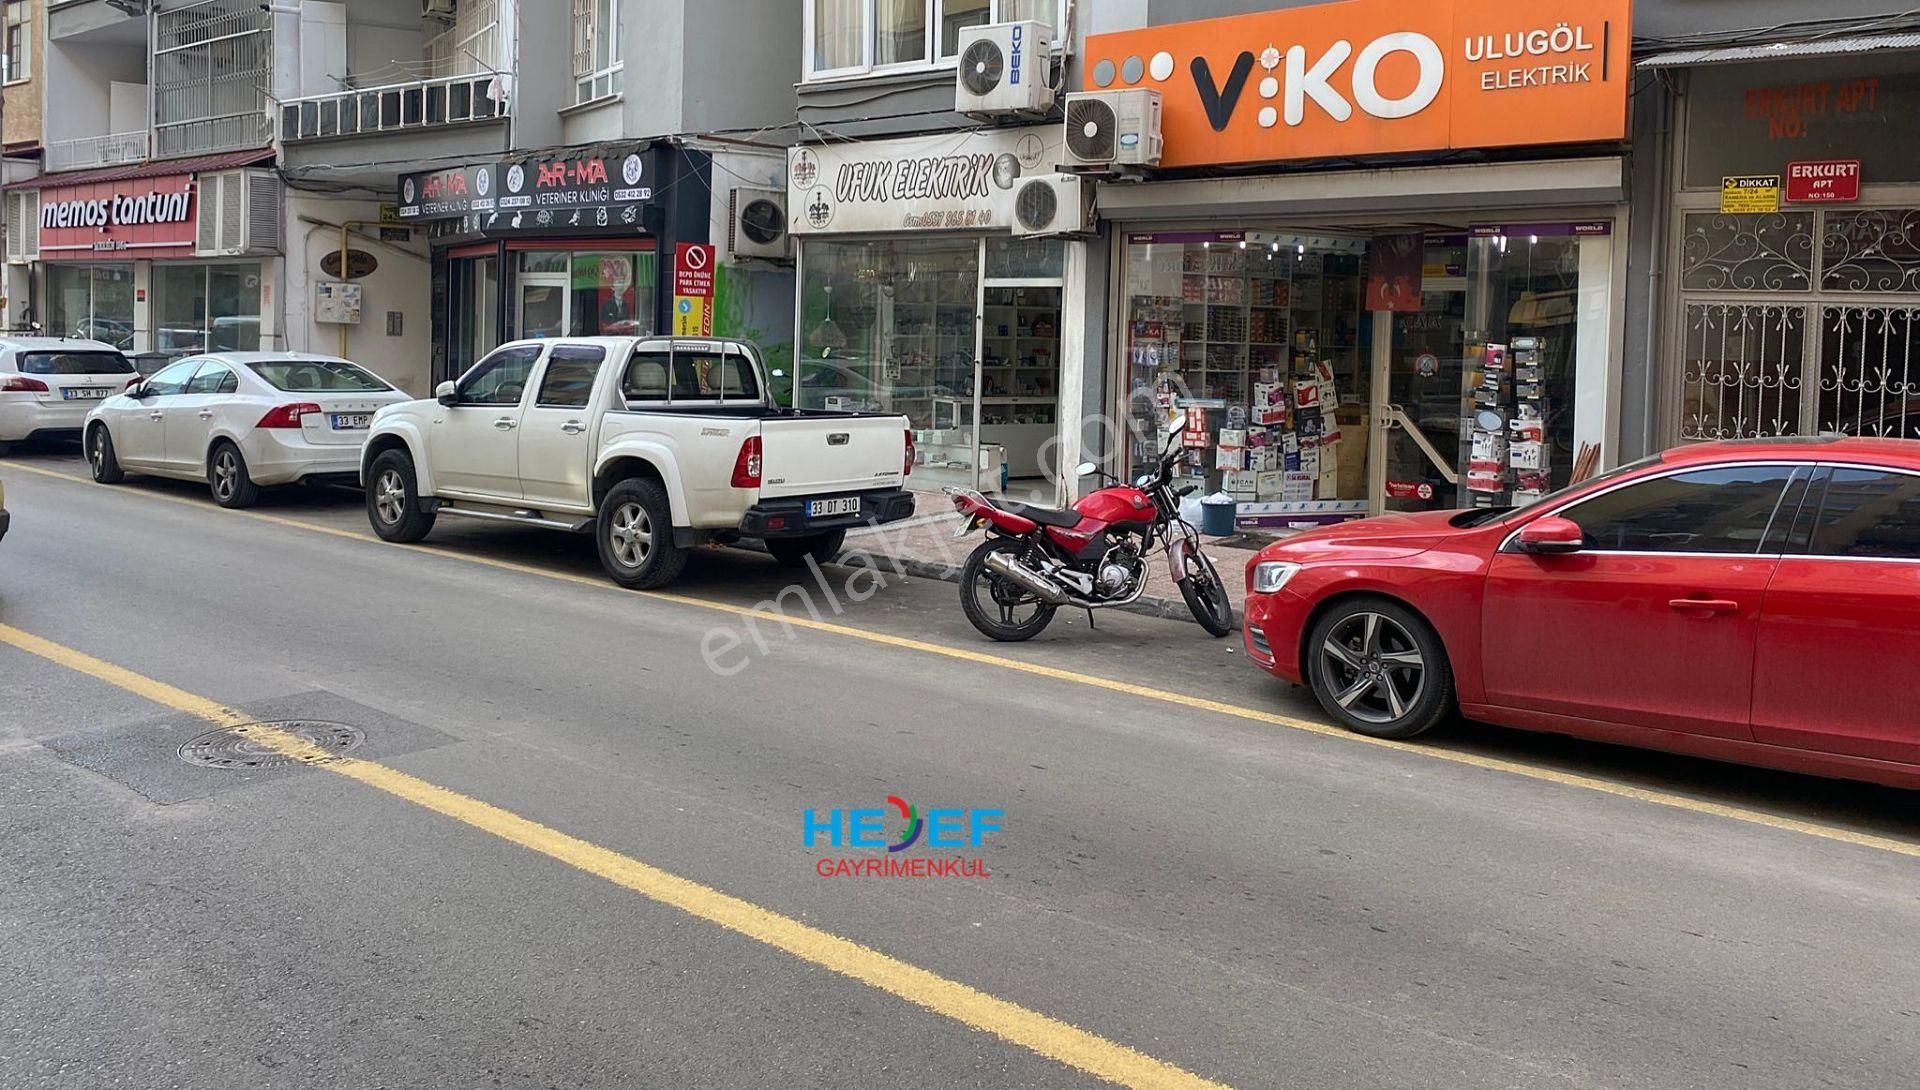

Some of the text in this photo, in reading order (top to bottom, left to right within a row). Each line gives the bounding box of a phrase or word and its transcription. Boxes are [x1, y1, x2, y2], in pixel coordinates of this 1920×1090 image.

[1010, 25, 1022, 85] BEKO
[1464, 22, 1594, 62] ULUGÖL
[1481, 60, 1592, 91] ELEKTRİK
[1746, 79, 1880, 118] ERKURT APT
[536, 158, 609, 188] AR-MA
[836, 154, 994, 203] UFUK ELEKTRİK
[1739, 178, 1775, 188] DİKKAT
[1792, 164, 1857, 179] ERKURT
[1812, 179, 1833, 189] APT
[41, 183, 191, 233] memoş tantuni
[535, 186, 610, 205] VETERİNER KLİNİĞİ
[339, 415, 368, 426] 33 EMP
[812, 499, 858, 515] 33 DT 310
